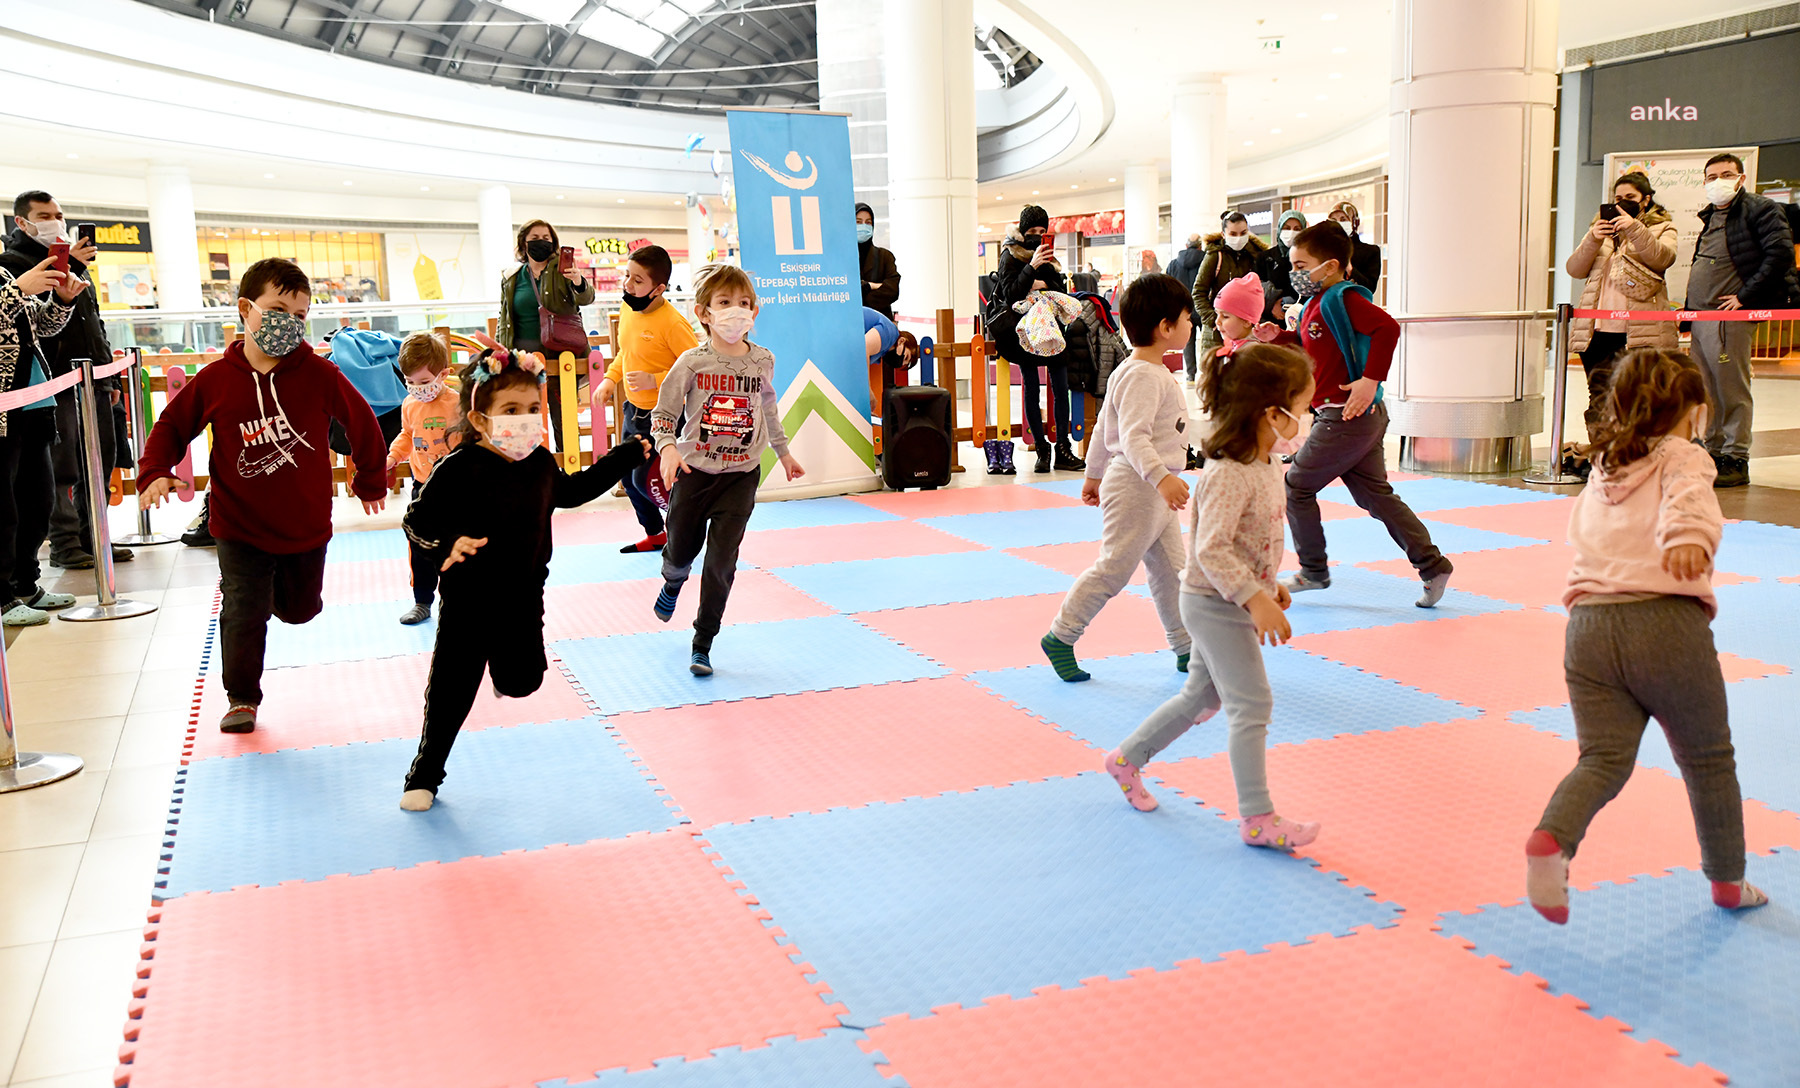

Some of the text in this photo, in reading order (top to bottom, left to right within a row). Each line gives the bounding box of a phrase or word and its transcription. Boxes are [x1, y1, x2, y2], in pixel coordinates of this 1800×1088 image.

[95, 223, 141, 244] outlet
[778, 292, 800, 306] İşleri
[802, 292, 850, 304] Müdürlüğü
[239, 416, 290, 447] NIKE
[264, 462, 279, 476] JUST
